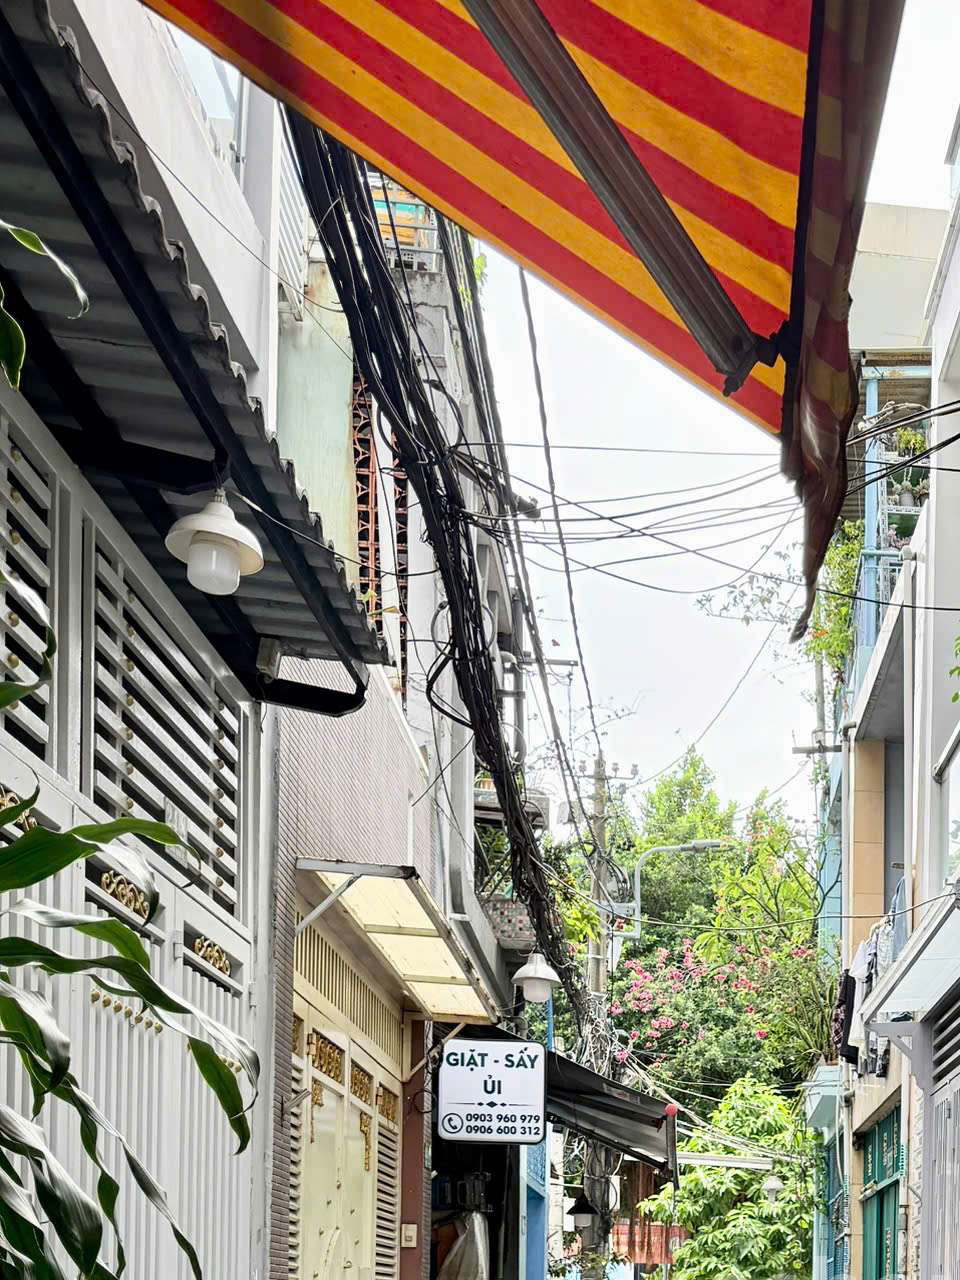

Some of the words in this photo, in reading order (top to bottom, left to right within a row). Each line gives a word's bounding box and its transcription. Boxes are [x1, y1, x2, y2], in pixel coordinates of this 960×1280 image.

[446, 1049, 488, 1072] GIẶT
[504, 1047, 539, 1069] SẤY
[483, 1074, 502, 1094] ỦI
[465, 1113, 493, 1123] 0903
[496, 1114, 517, 1123] 960
[519, 1114, 540, 1124] 979
[465, 1125, 493, 1134] 0906
[496, 1125, 517, 1135] 600
[520, 1126, 540, 1135] 312
